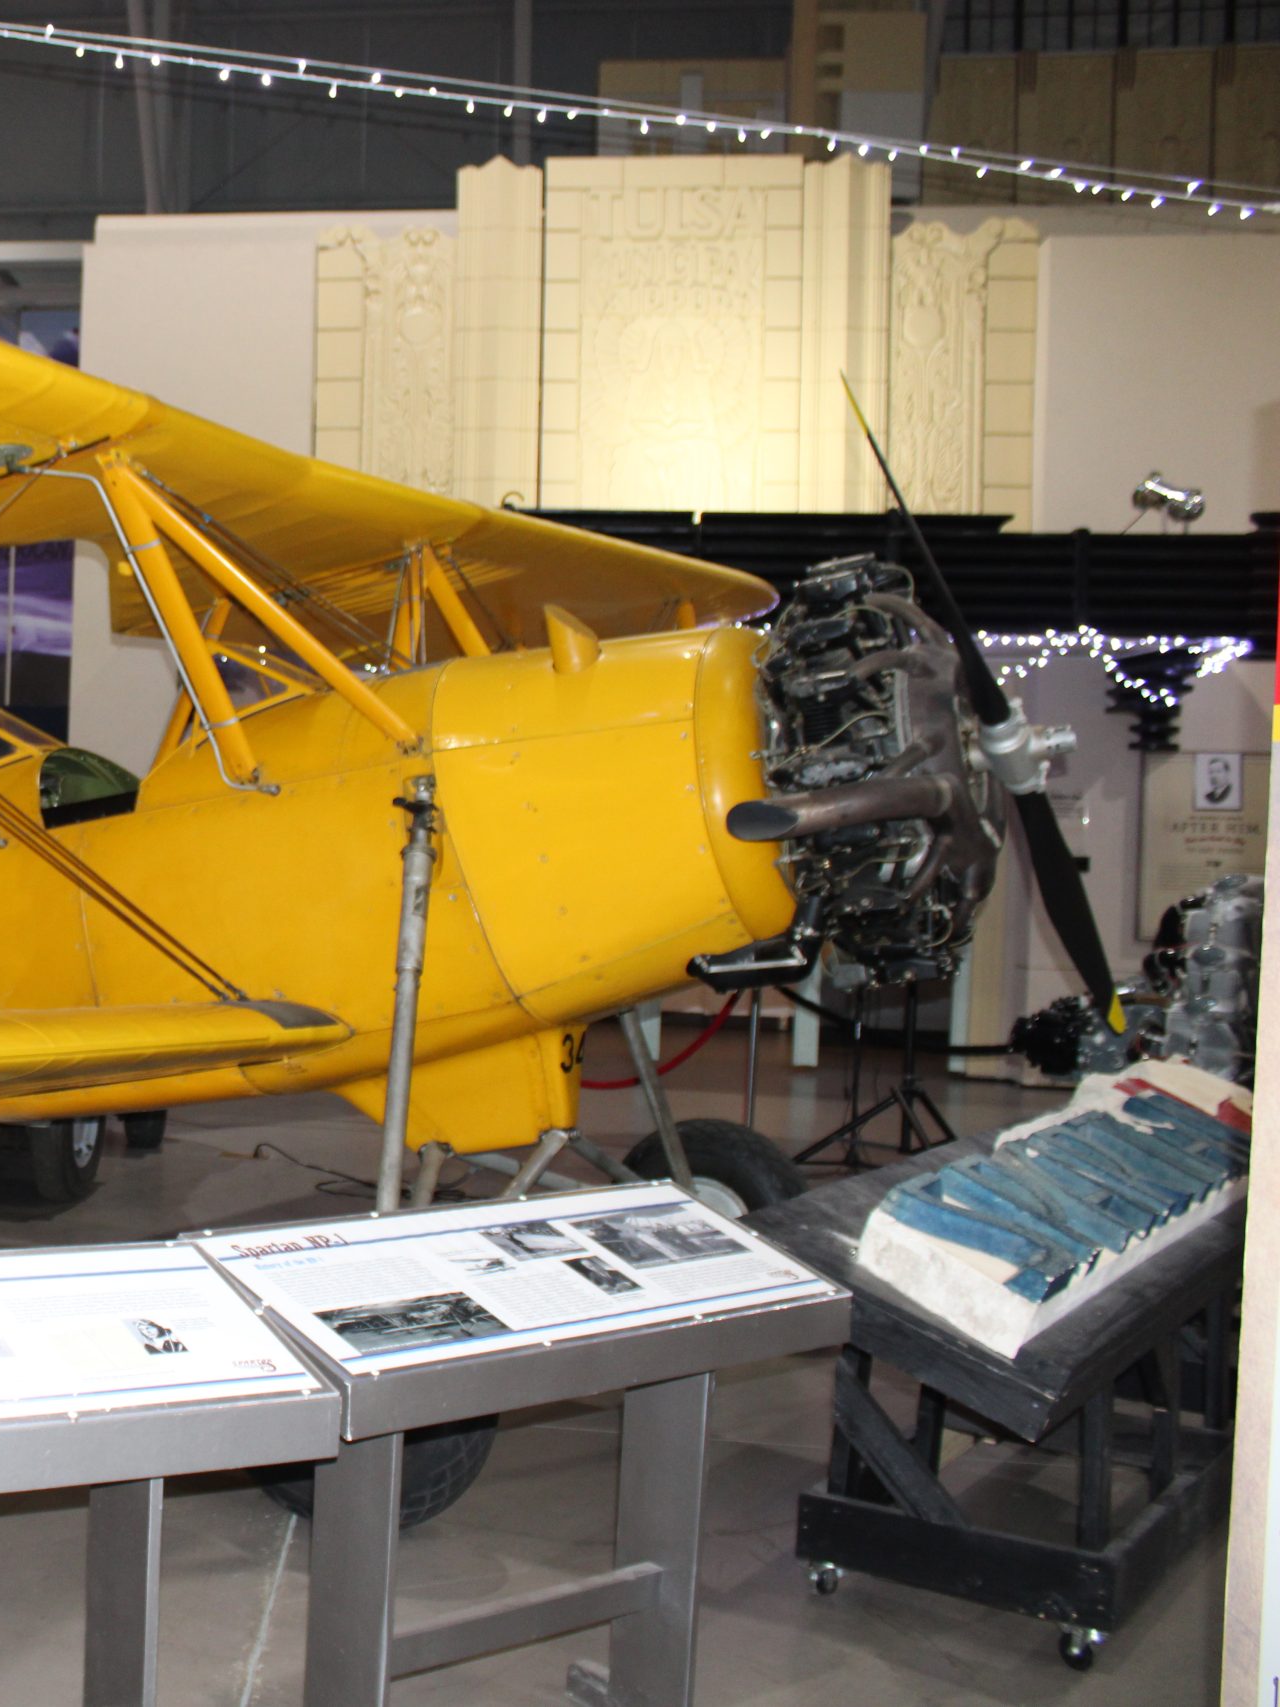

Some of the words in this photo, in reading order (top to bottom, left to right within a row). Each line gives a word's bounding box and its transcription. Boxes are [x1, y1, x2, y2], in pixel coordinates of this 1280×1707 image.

[587, 186, 764, 240] TULSA
[231, 1241, 304, 1260] Spartan
[303, 1233, 352, 1249] NP-1
